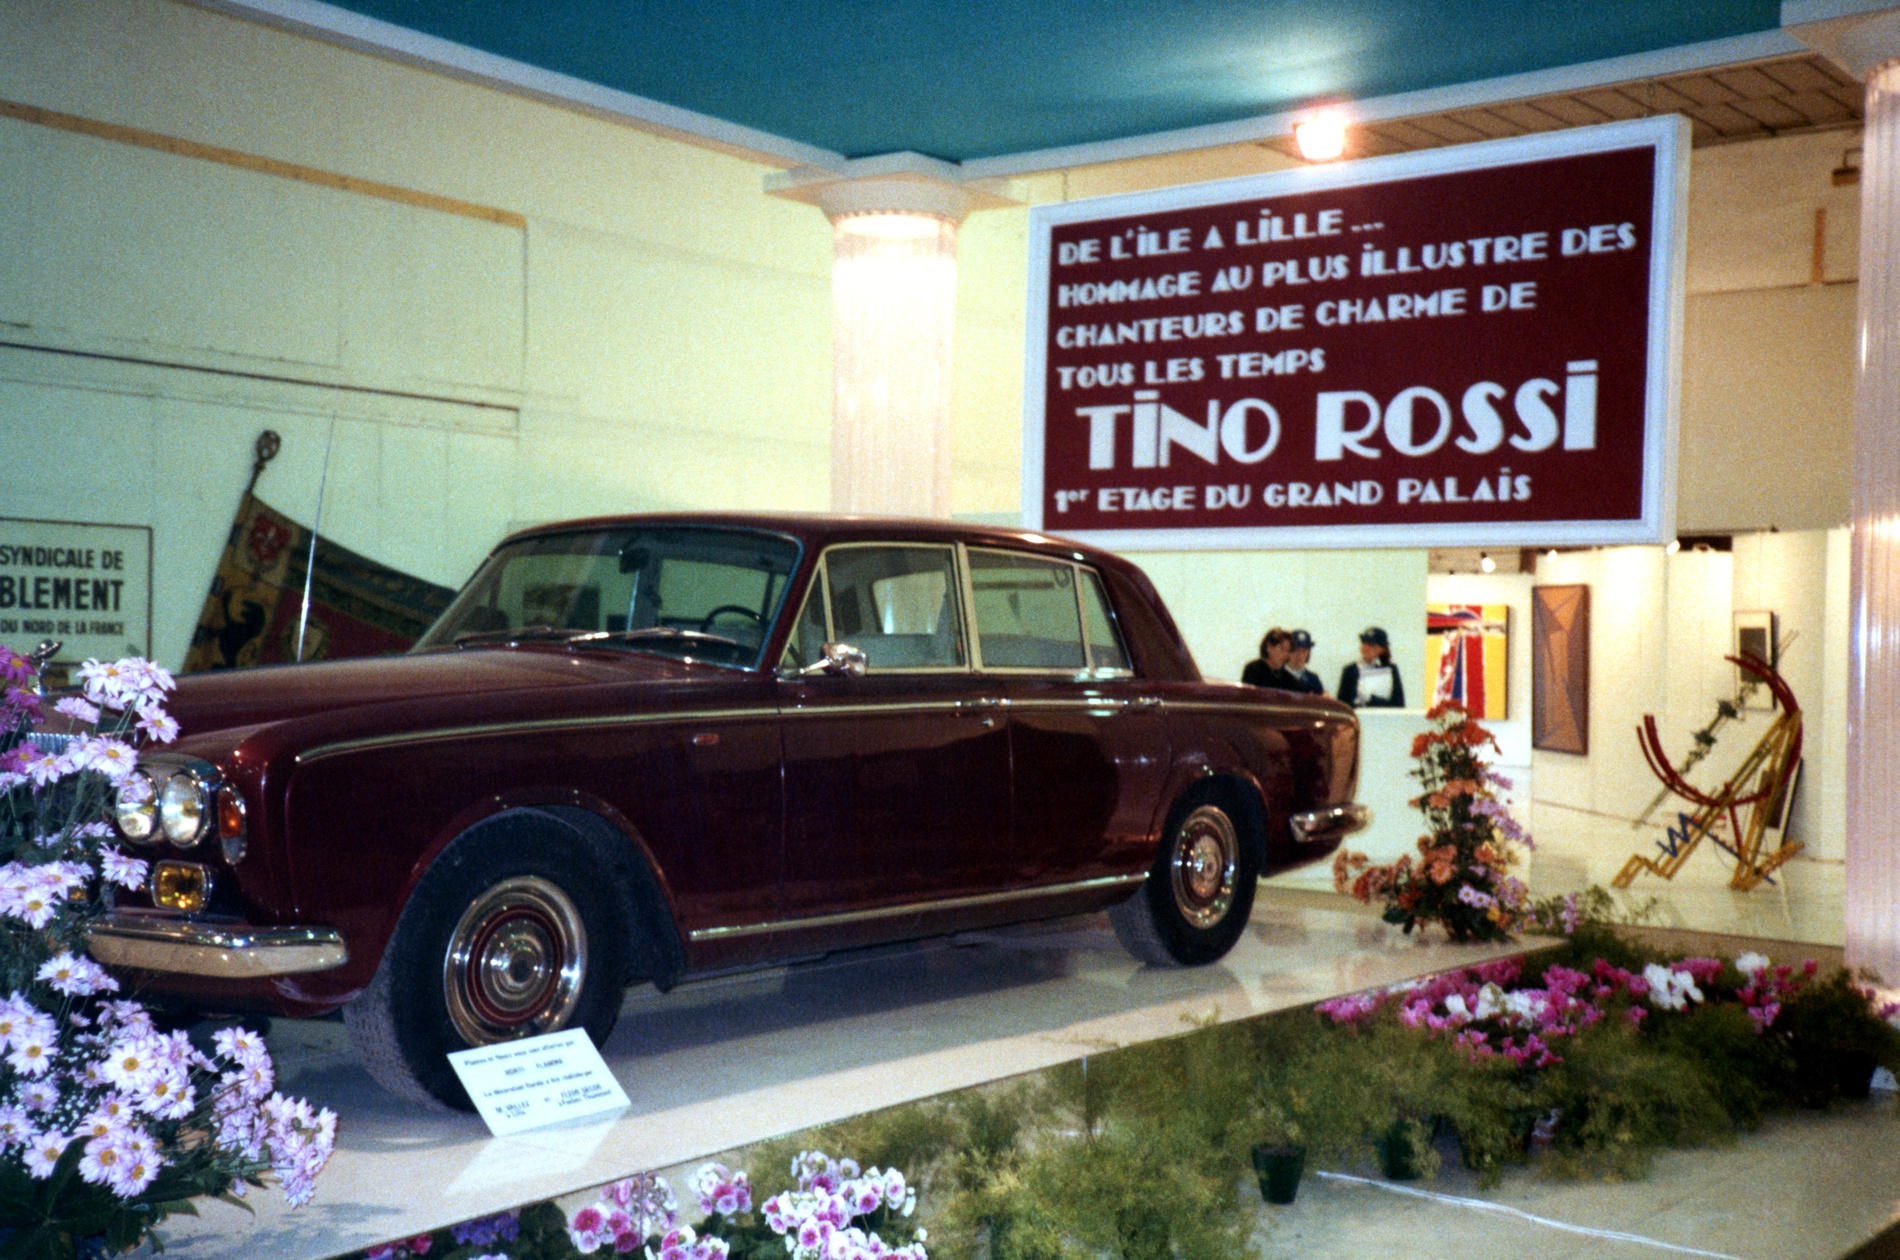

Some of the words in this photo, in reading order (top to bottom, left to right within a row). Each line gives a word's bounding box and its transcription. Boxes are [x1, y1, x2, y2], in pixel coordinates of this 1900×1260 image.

[1058, 238, 1100, 266] DE
[1202, 224, 1225, 249] A
[1058, 271, 1201, 308] HOMMAGE
[1210, 264, 1254, 293] AU
[1262, 254, 1349, 288] PLUS
[1561, 221, 1638, 256] DES
[1056, 310, 1245, 349] CHANTEURS
[1256, 303, 1305, 333] DE
[1315, 287, 1468, 327] CHARME
[1481, 281, 1538, 312] DE
[1057, 362, 1135, 390] TOUS
[1144, 357, 1205, 385] LES
[1216, 348, 1326, 379] TEMPS
[1054, 488, 1091, 513] 1er
[1097, 485, 1196, 512] ETAGE
[1205, 483, 1252, 510] DU
[1262, 479, 1385, 508] GRAND
[0, 544, 95, 569] SYNDICALE
[101, 549, 125, 571] DE
[0, 574, 125, 612] BLEMENT
[57, 620, 71, 636] DE
[75, 620, 88, 635] LA
